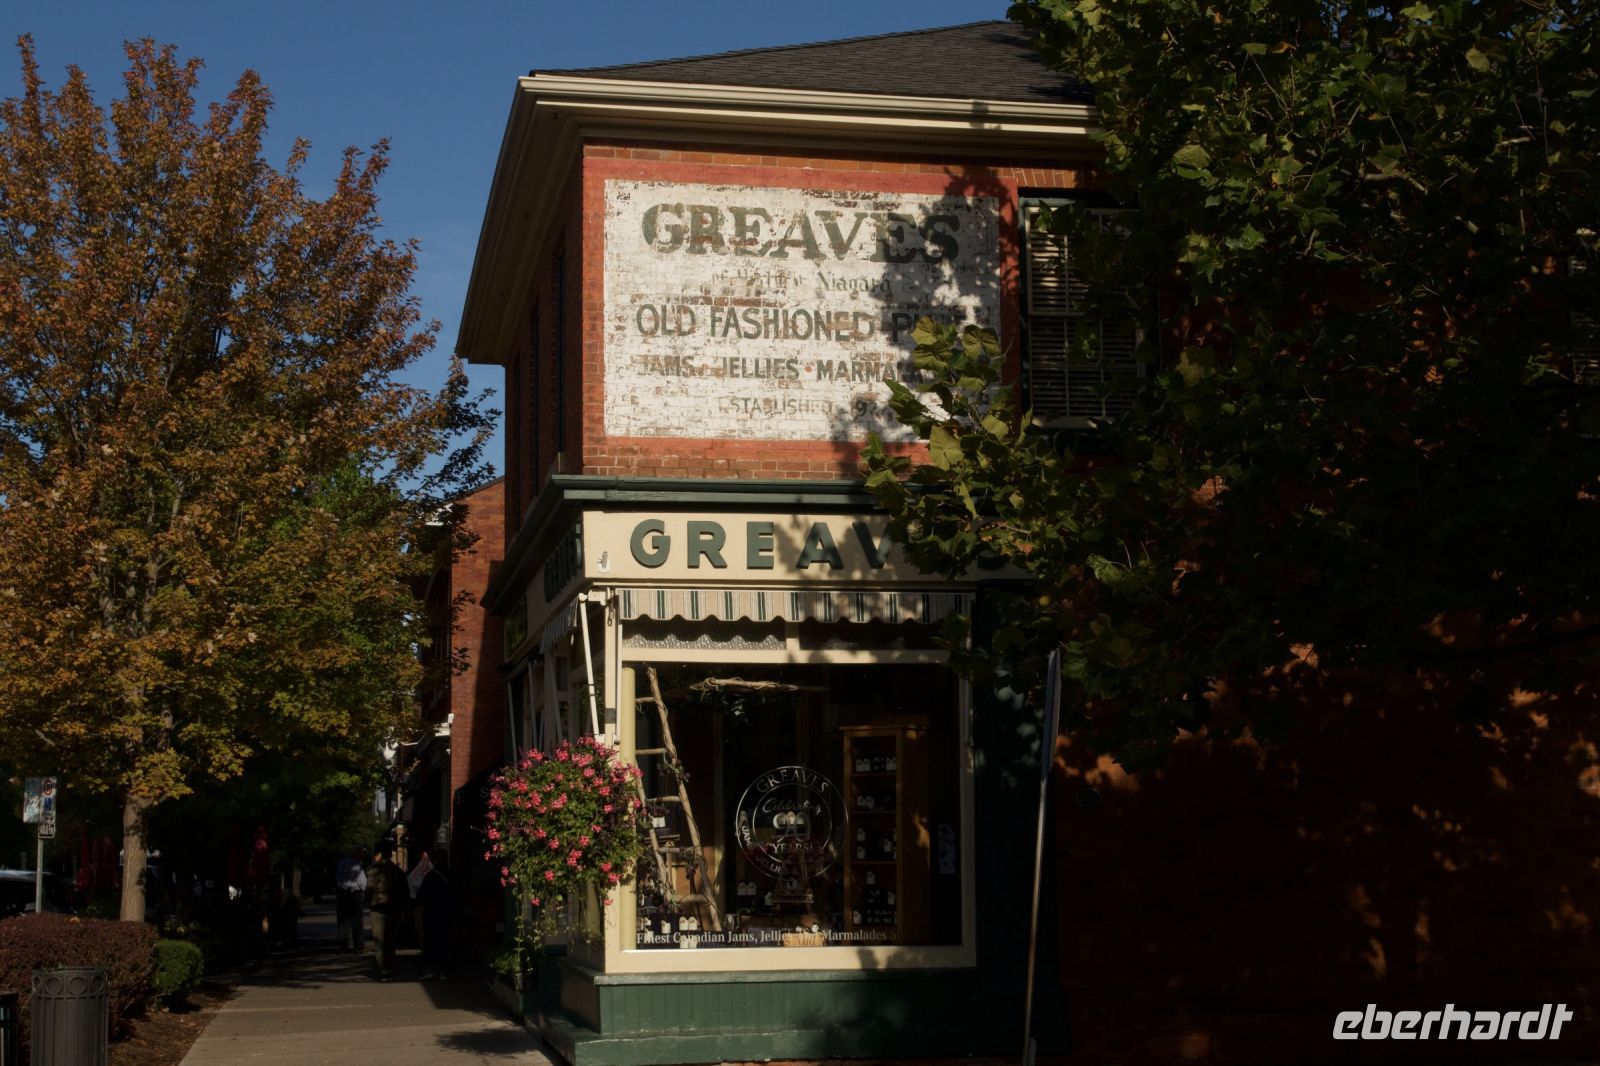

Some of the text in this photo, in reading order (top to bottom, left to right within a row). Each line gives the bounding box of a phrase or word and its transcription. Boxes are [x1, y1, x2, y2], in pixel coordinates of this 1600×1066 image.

[642, 202, 960, 263] GREAVES
[816, 270, 892, 294] Niagara
[636, 304, 695, 336] OLD
[710, 305, 876, 341] FASHIONED
[722, 357, 800, 381] JELLIES
[718, 396, 833, 417] ESTABLISHD
[756, 769, 830, 793] GREAVES
[727, 930, 758, 944] Jams,
